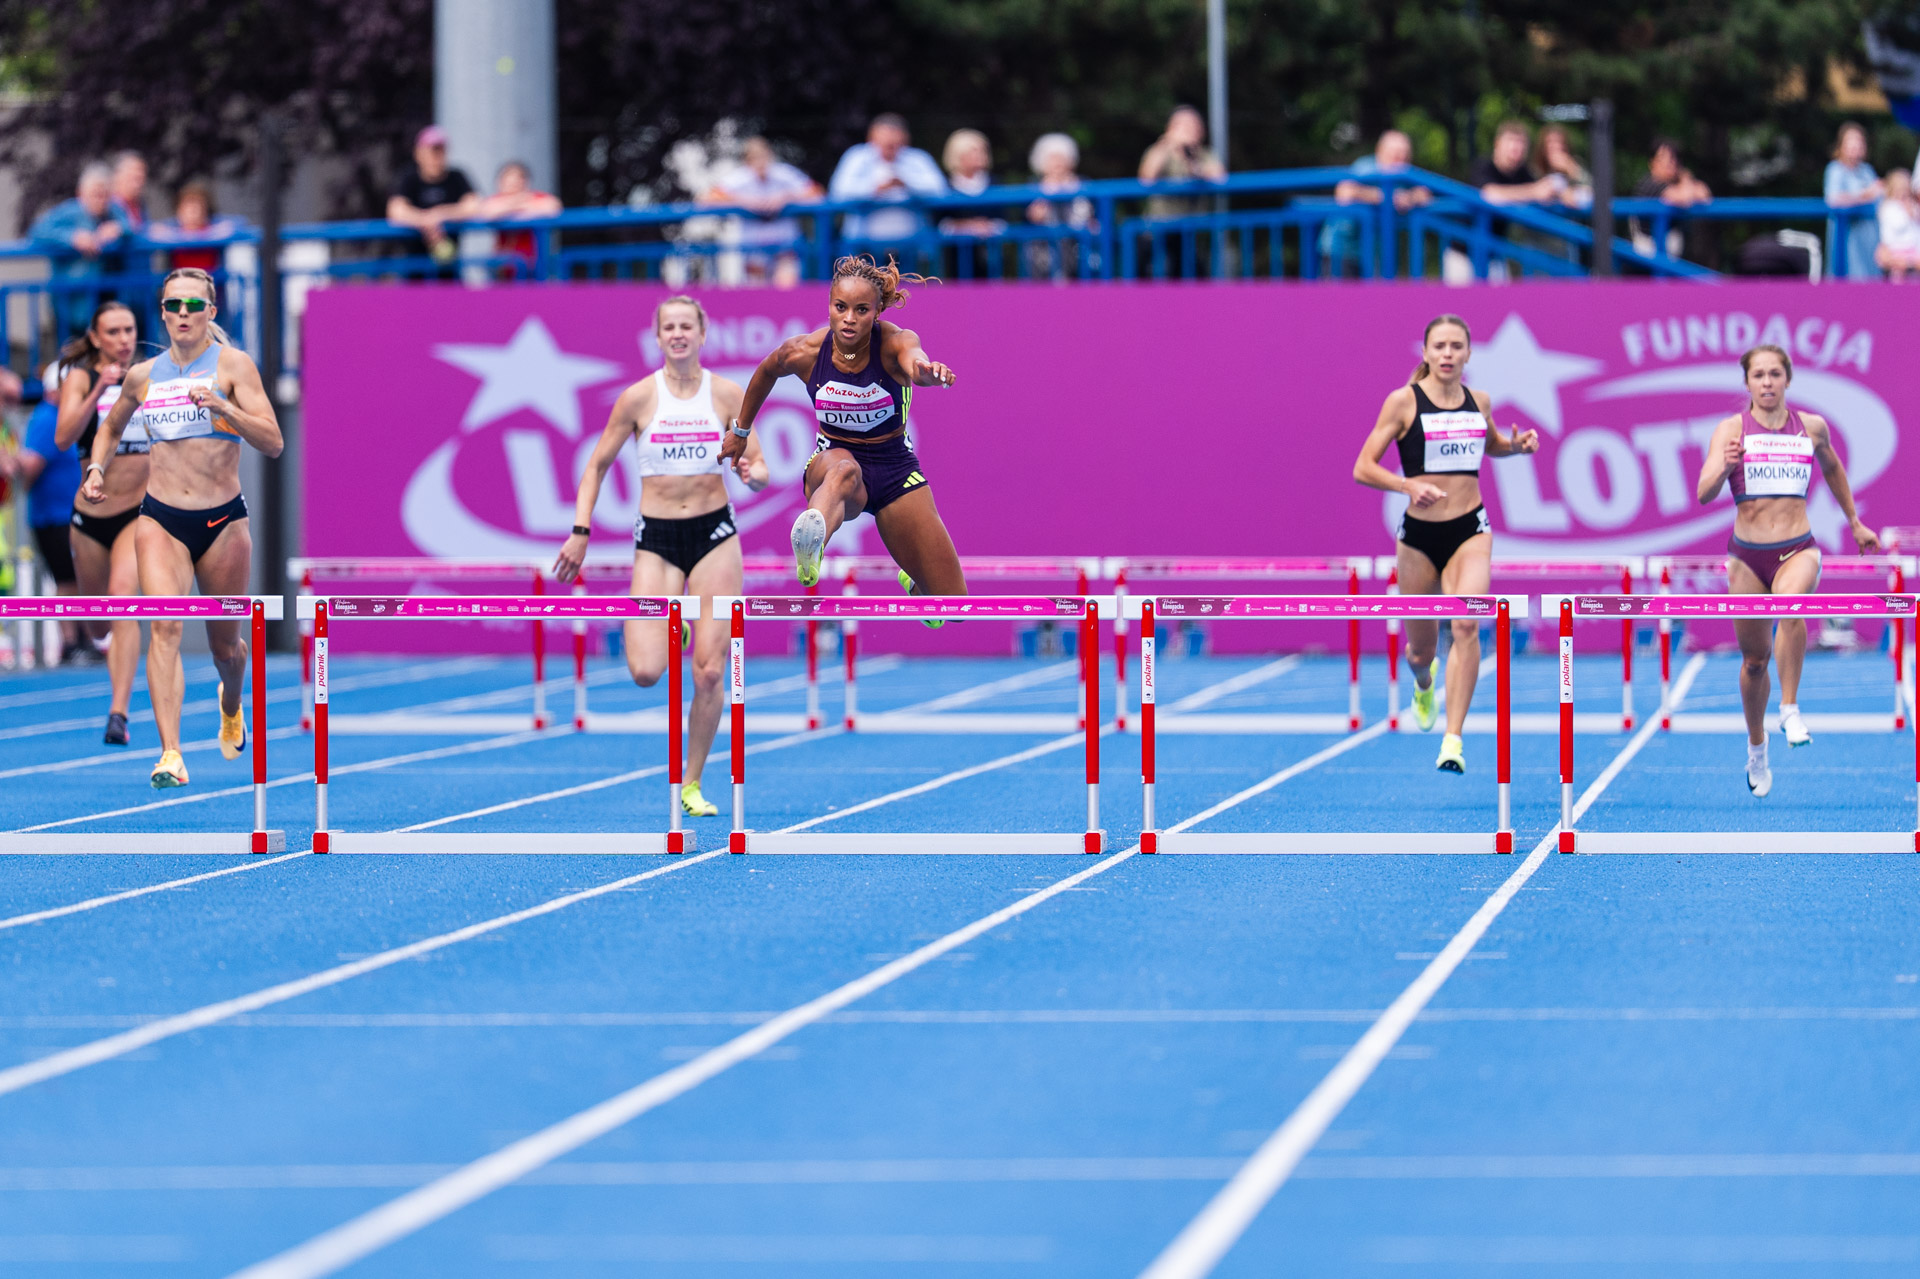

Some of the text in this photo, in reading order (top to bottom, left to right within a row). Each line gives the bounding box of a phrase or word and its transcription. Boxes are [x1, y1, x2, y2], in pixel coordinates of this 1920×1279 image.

[1621, 312, 1873, 373] FUNDACJA
[145, 409, 207, 425] TKACHUK
[825, 409, 888, 424] DIALLO
[663, 443, 707, 460] MÁTÓ
[1440, 442, 1475, 456] GRYC
[1748, 463, 1808, 481] SMOLIŃSKA
[317, 653, 326, 687] polanik
[733, 653, 742, 687] polanik
[1144, 653, 1153, 687] polanik
[1562, 652, 1571, 686] polanik
